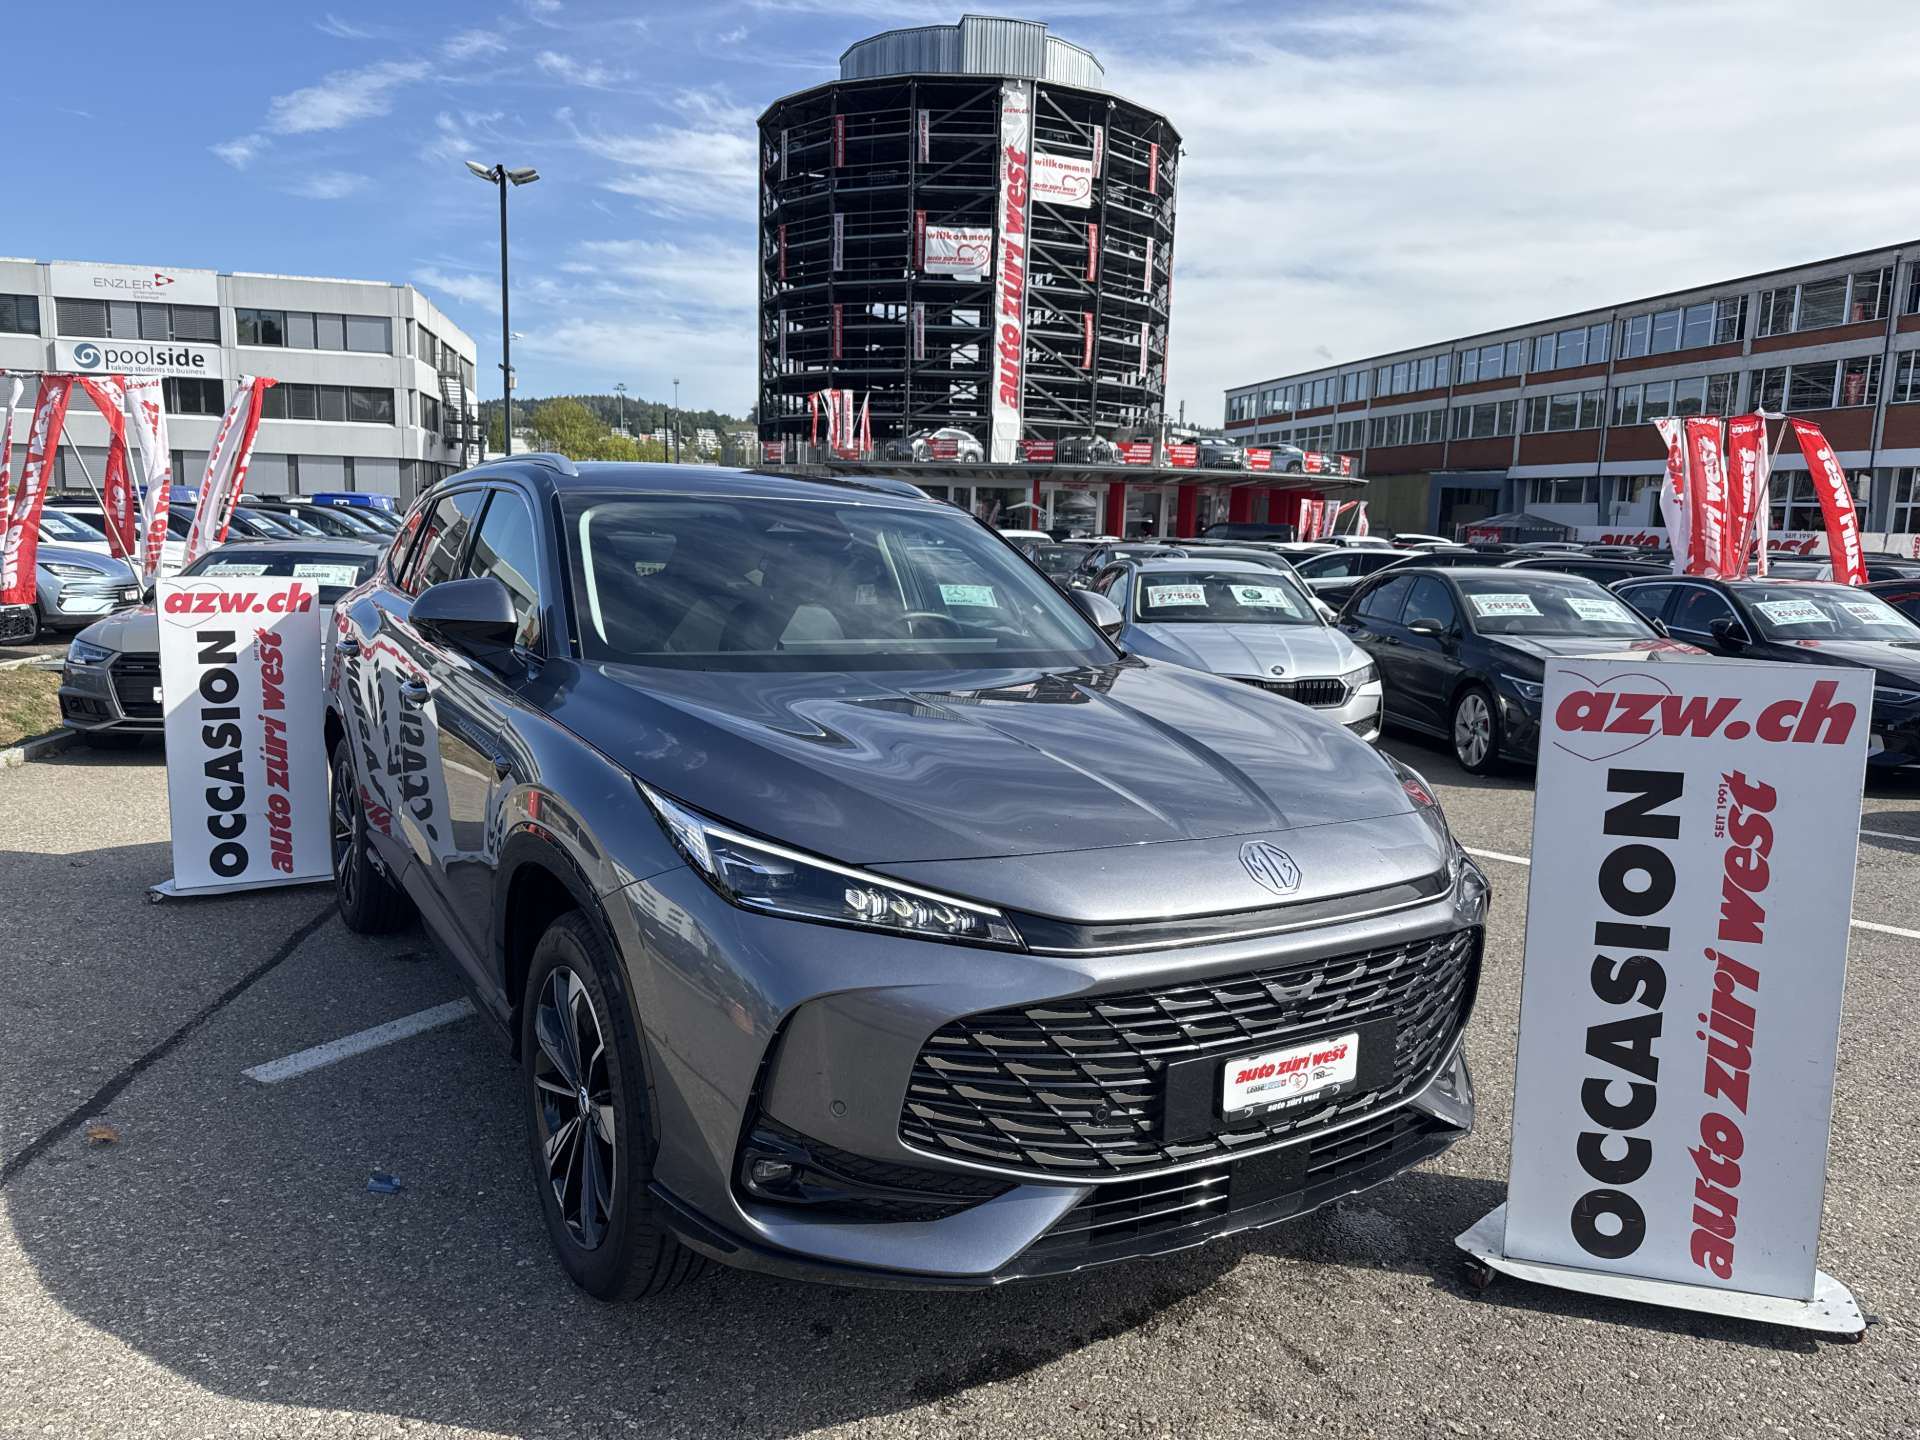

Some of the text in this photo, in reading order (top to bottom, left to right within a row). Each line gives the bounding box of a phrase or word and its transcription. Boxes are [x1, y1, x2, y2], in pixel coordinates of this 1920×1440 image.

[1034, 158, 1090, 174] willkommen
[927, 230, 990, 240] willkommen
[93, 277, 153, 290] ENZLER
[999, 145, 1027, 409] auto züri west
[105, 346, 205, 370] poolside
[111, 365, 133, 374] taking
[135, 366, 165, 374] students
[1699, 436, 1723, 502] west
[1701, 503, 1722, 564] züri
[164, 583, 312, 614] azw.ch
[1555, 680, 1858, 745] azw.ch
[196, 630, 249, 878] OCCASION
[254, 627, 294, 874] auto züri west
[1715, 783, 1728, 838] SEIT 1991
[1570, 768, 1685, 1260] OCCASION
[1691, 769, 1778, 1280] auto züri west
[1235, 1044, 1348, 1084] auto züri west
[1267, 1102, 1286, 1112] auto
[1303, 1092, 1320, 1103] west
